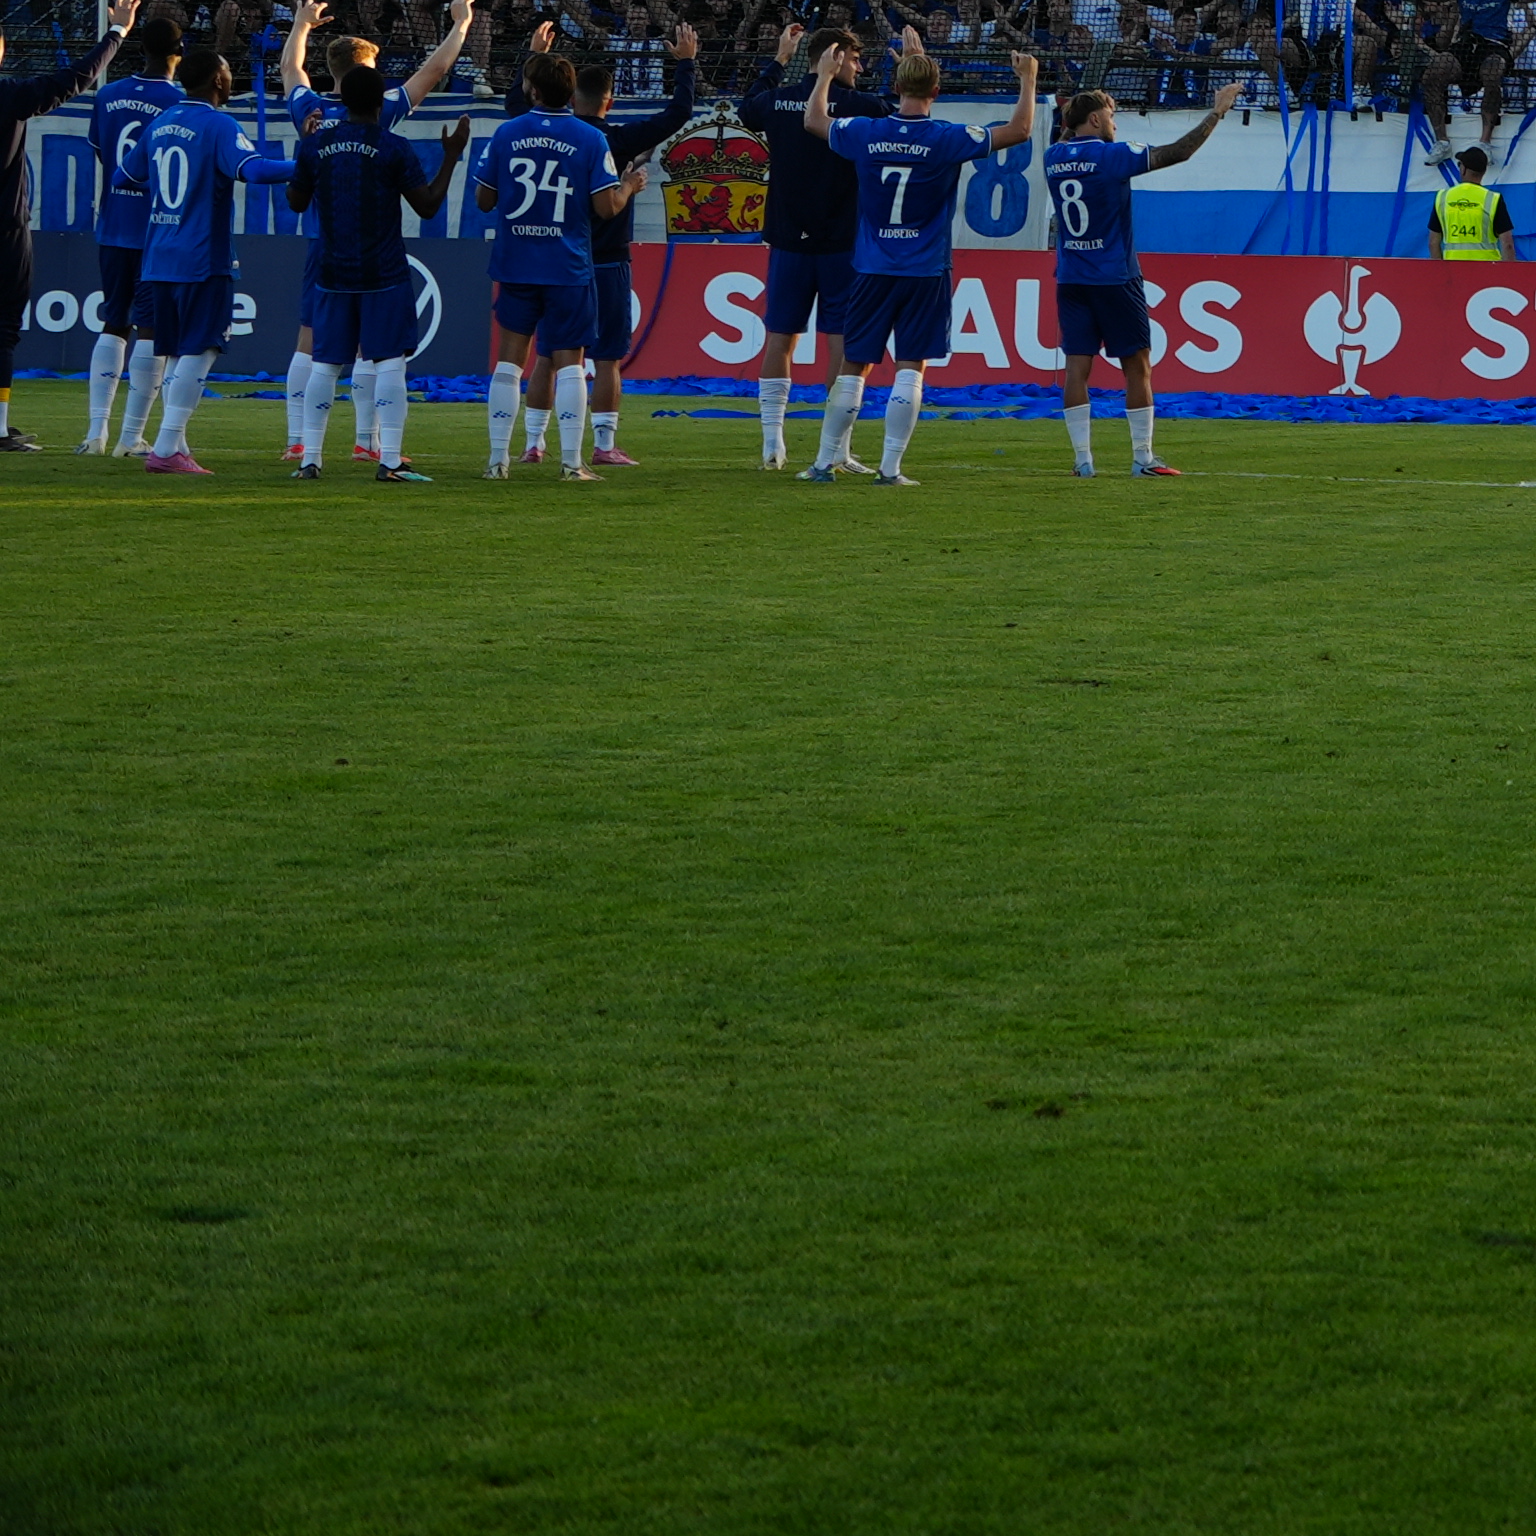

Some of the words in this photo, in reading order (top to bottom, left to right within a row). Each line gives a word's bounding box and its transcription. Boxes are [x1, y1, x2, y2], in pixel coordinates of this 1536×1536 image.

[106, 99, 163, 117] DARMSTADT
[317, 141, 379, 159] DARMSTADT
[511, 137, 578, 156] DARMSTADT
[868, 142, 932, 157] DARMSTADT
[152, 145, 189, 209] 10
[1046, 162, 1097, 177] DARMSTADT
[504, 157, 574, 223] 34
[881, 166, 913, 224] 7
[1059, 179, 1089, 237] 8
[512, 225, 563, 238] CORREDOR
[879, 228, 919, 239] LIDBERG
[1451, 225, 1477, 238] 244
